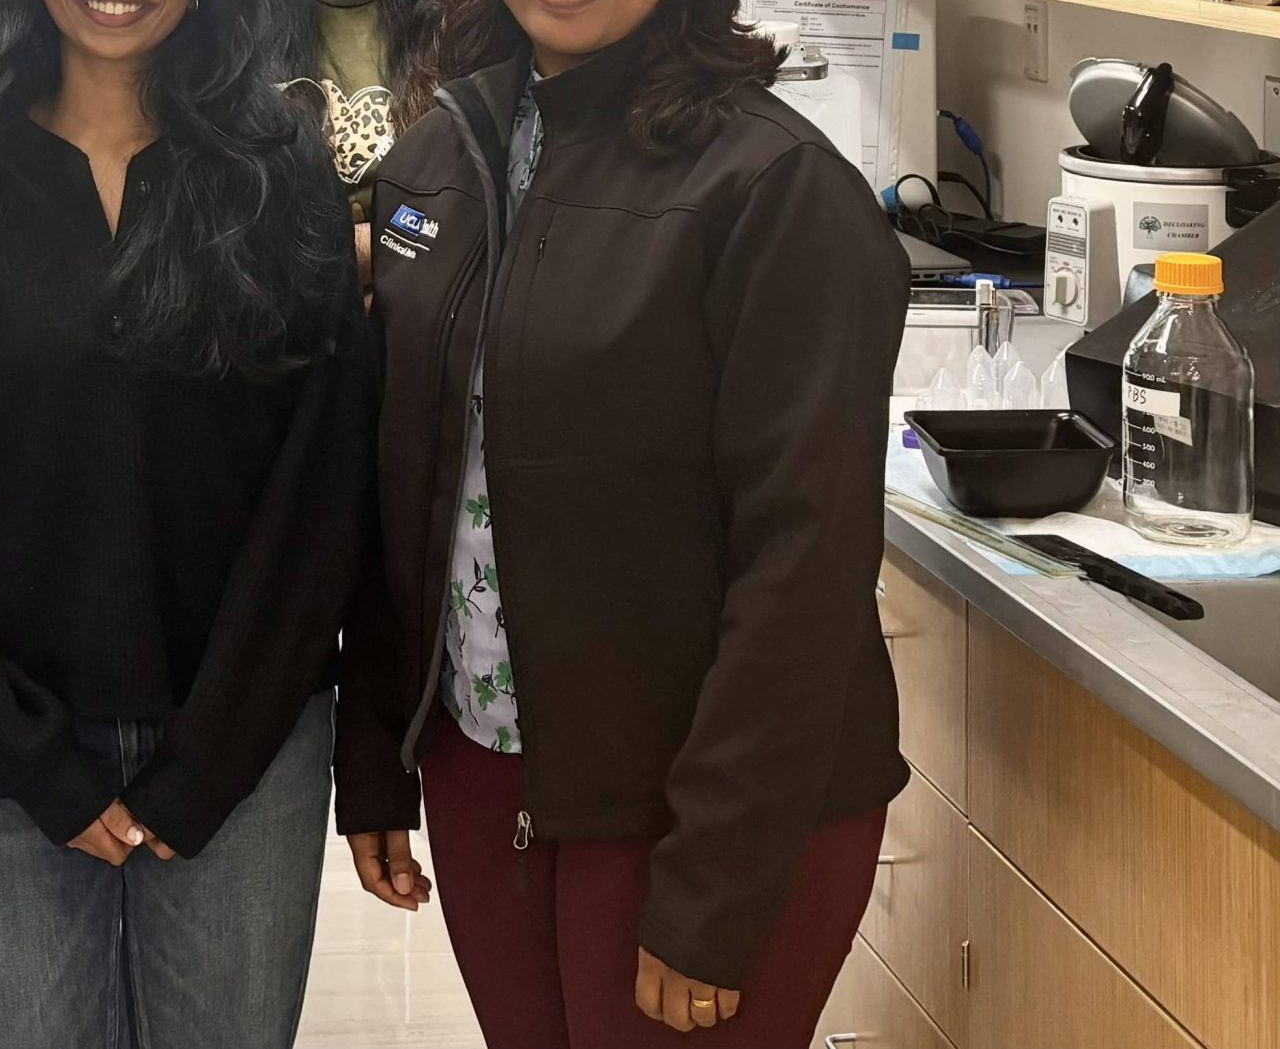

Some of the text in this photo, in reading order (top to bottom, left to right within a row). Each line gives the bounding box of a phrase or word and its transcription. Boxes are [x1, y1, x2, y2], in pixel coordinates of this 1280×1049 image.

[794, 0, 824, 8] Certificate
[1128, 385, 1146, 404] PBS
[1142, 426, 1155, 434] 600
